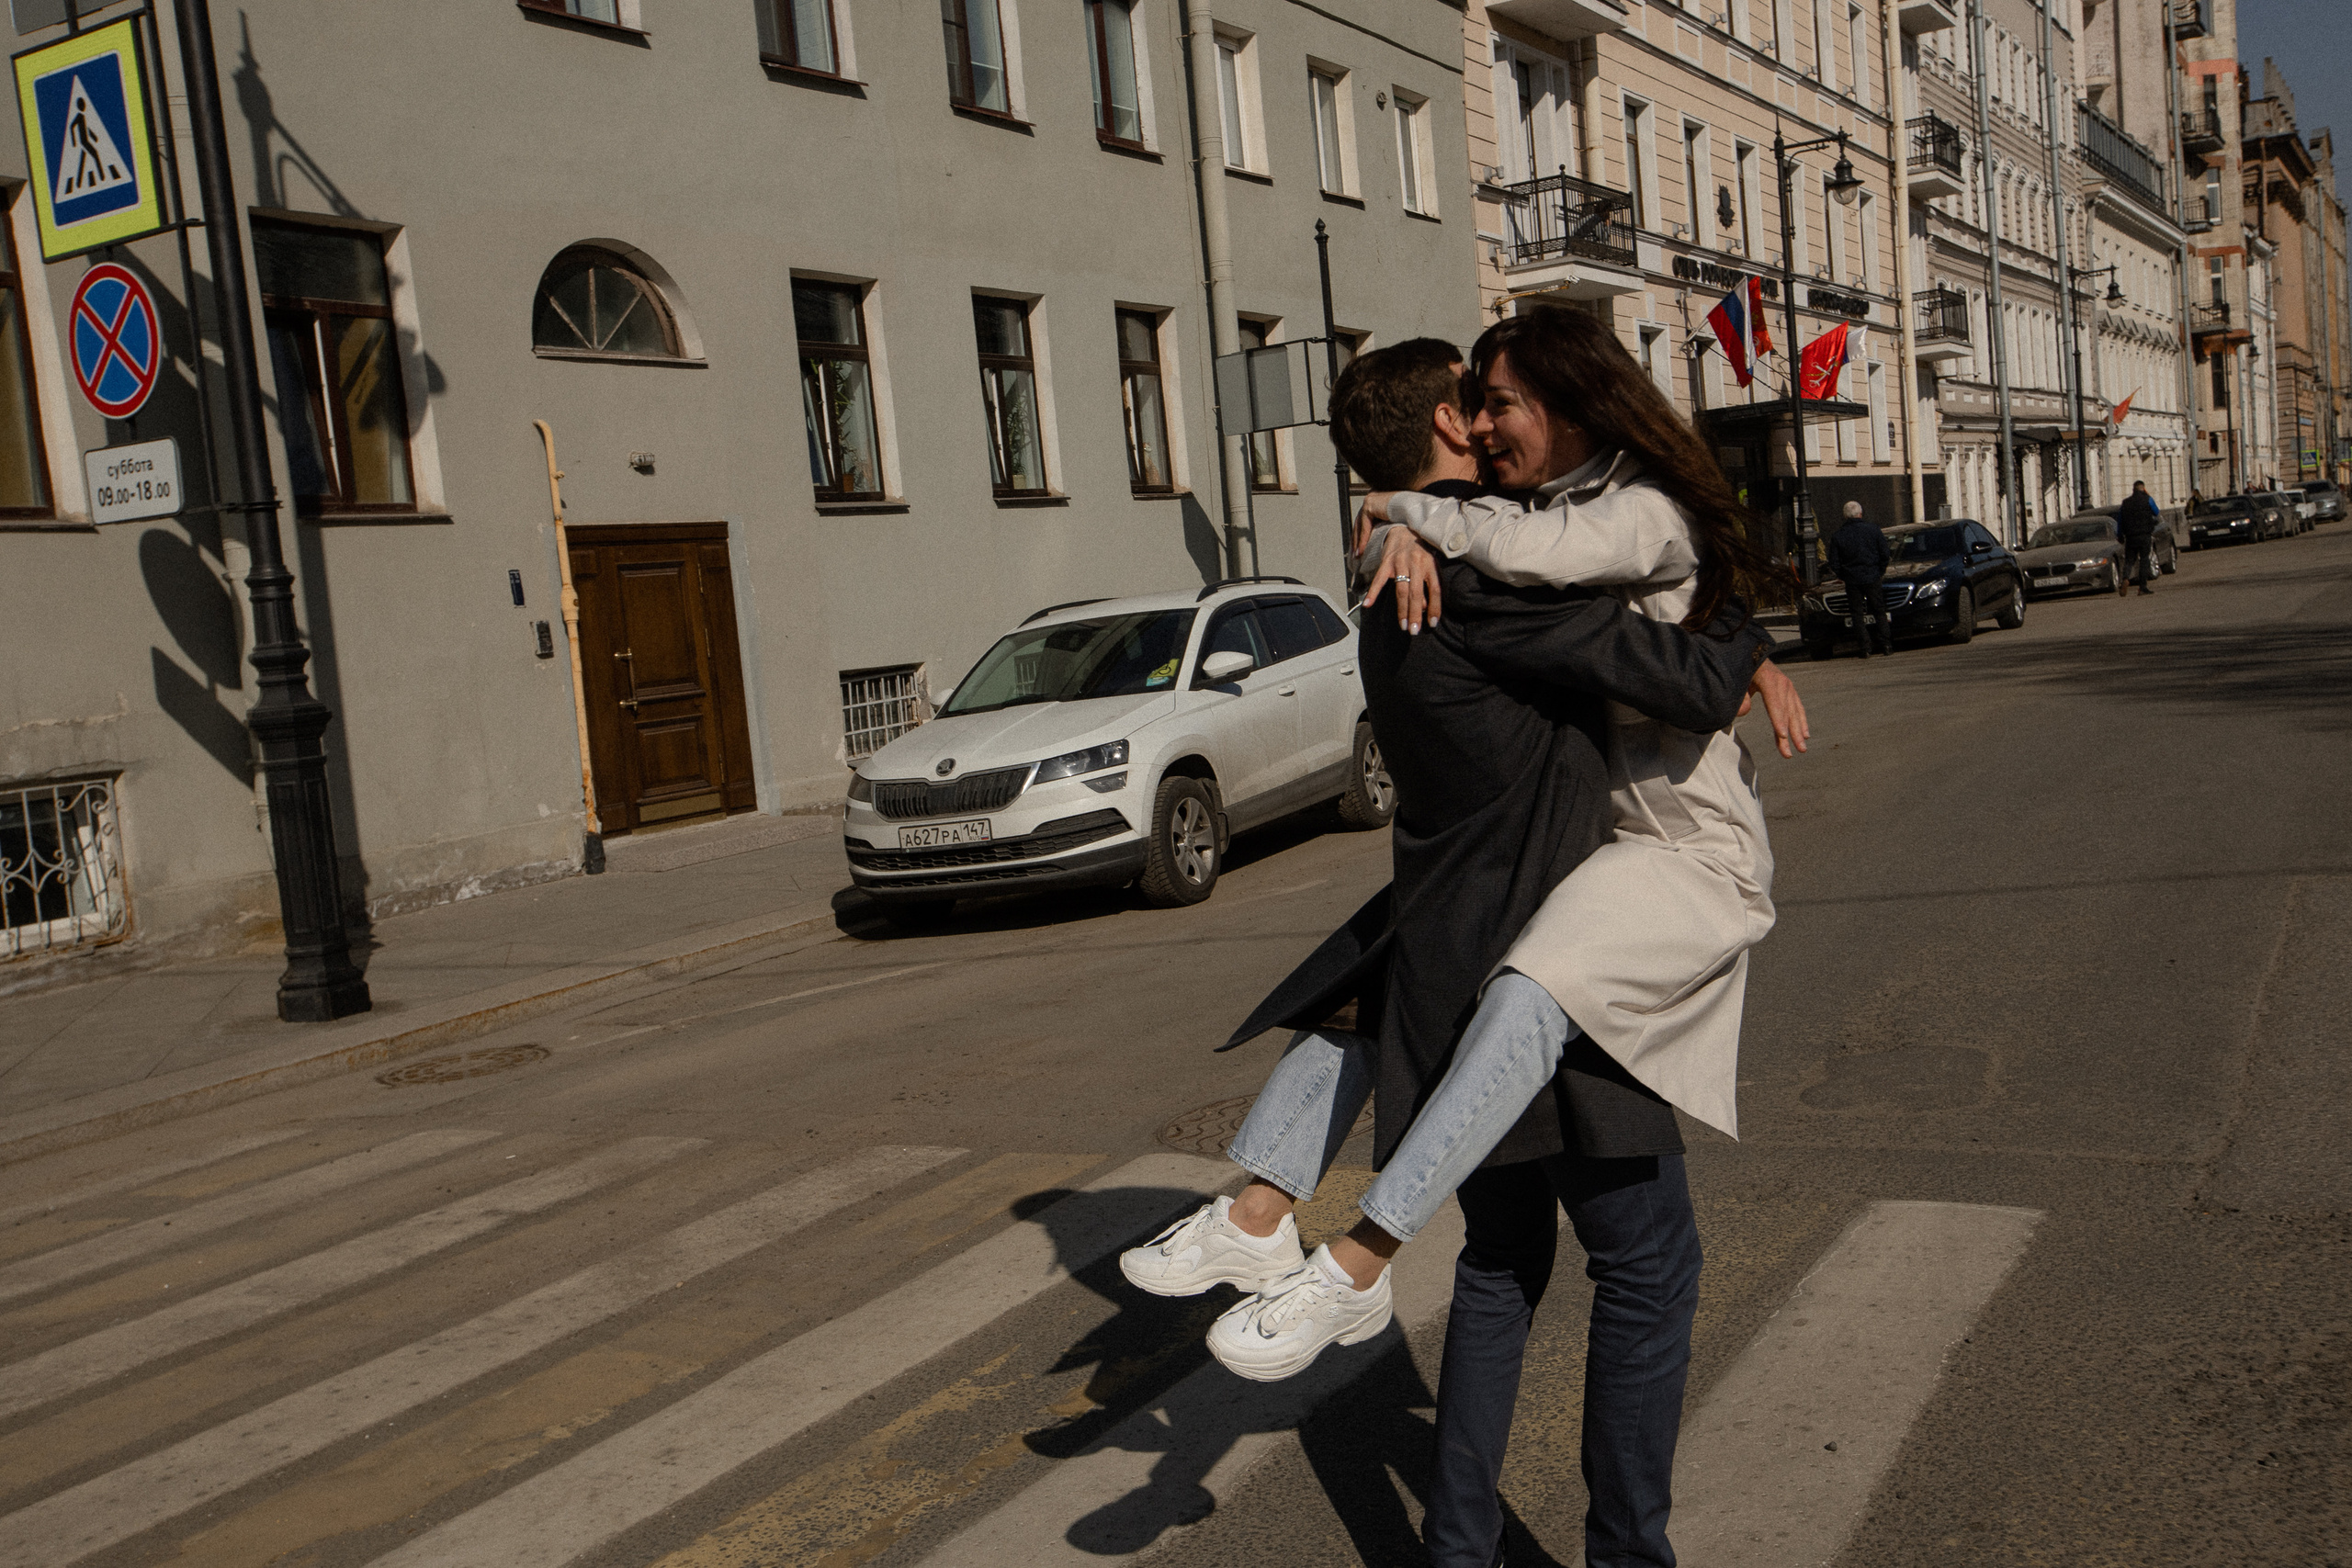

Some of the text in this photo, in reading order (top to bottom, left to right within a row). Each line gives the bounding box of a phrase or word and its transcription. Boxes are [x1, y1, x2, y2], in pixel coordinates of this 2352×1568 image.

[107, 458, 153, 479] суббота
[97, 480, 170, 507] 09.00-18.00
[963, 822, 985, 836] 147
